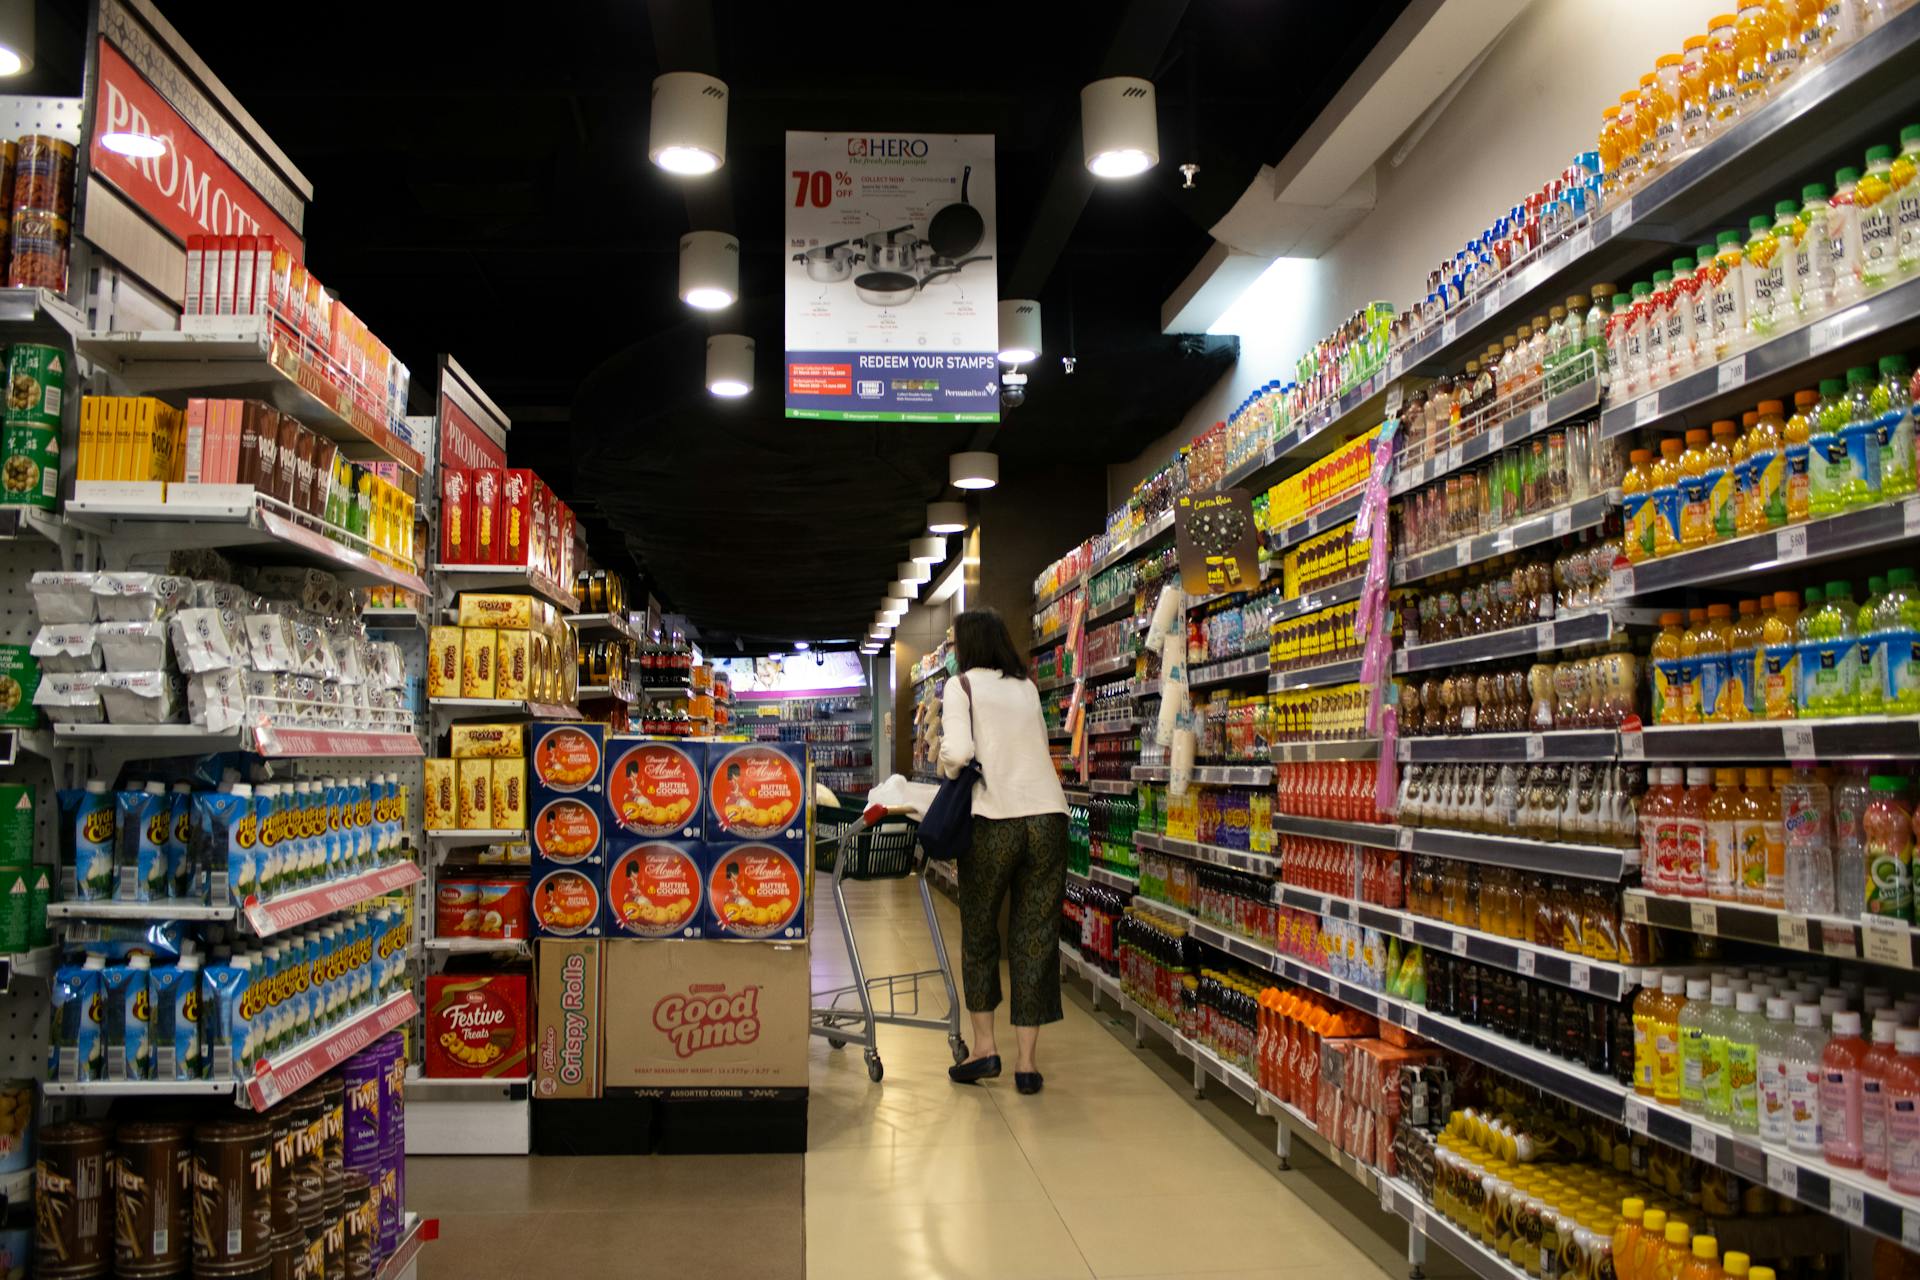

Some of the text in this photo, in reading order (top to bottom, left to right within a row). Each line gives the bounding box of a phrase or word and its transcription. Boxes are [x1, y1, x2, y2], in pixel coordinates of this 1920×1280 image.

[870, 139, 928, 158] HERO
[105, 80, 264, 235] PROMOT
[1901, 198, 1918, 210] tri
[1771, 267, 1783, 279] tri
[1717, 292, 1734, 303] tri
[1716, 301, 1735, 314] ost
[860, 356, 995, 370] REDEEM YOUR STAMPS
[656, 788, 690, 796] COOKIES
[656, 888, 690, 896] COOKIES
[563, 955, 583, 1010] Rolls
[443, 1003, 505, 1029] Festive
[655, 989, 757, 1029] Good
[326, 1026, 370, 1062] PROMOTION
[378, 1000, 413, 1030] PROMOTION
[462, 1028, 489, 1040] Treats
[671, 1018, 758, 1057] Time
[562, 1013, 588, 1084] Crispy
